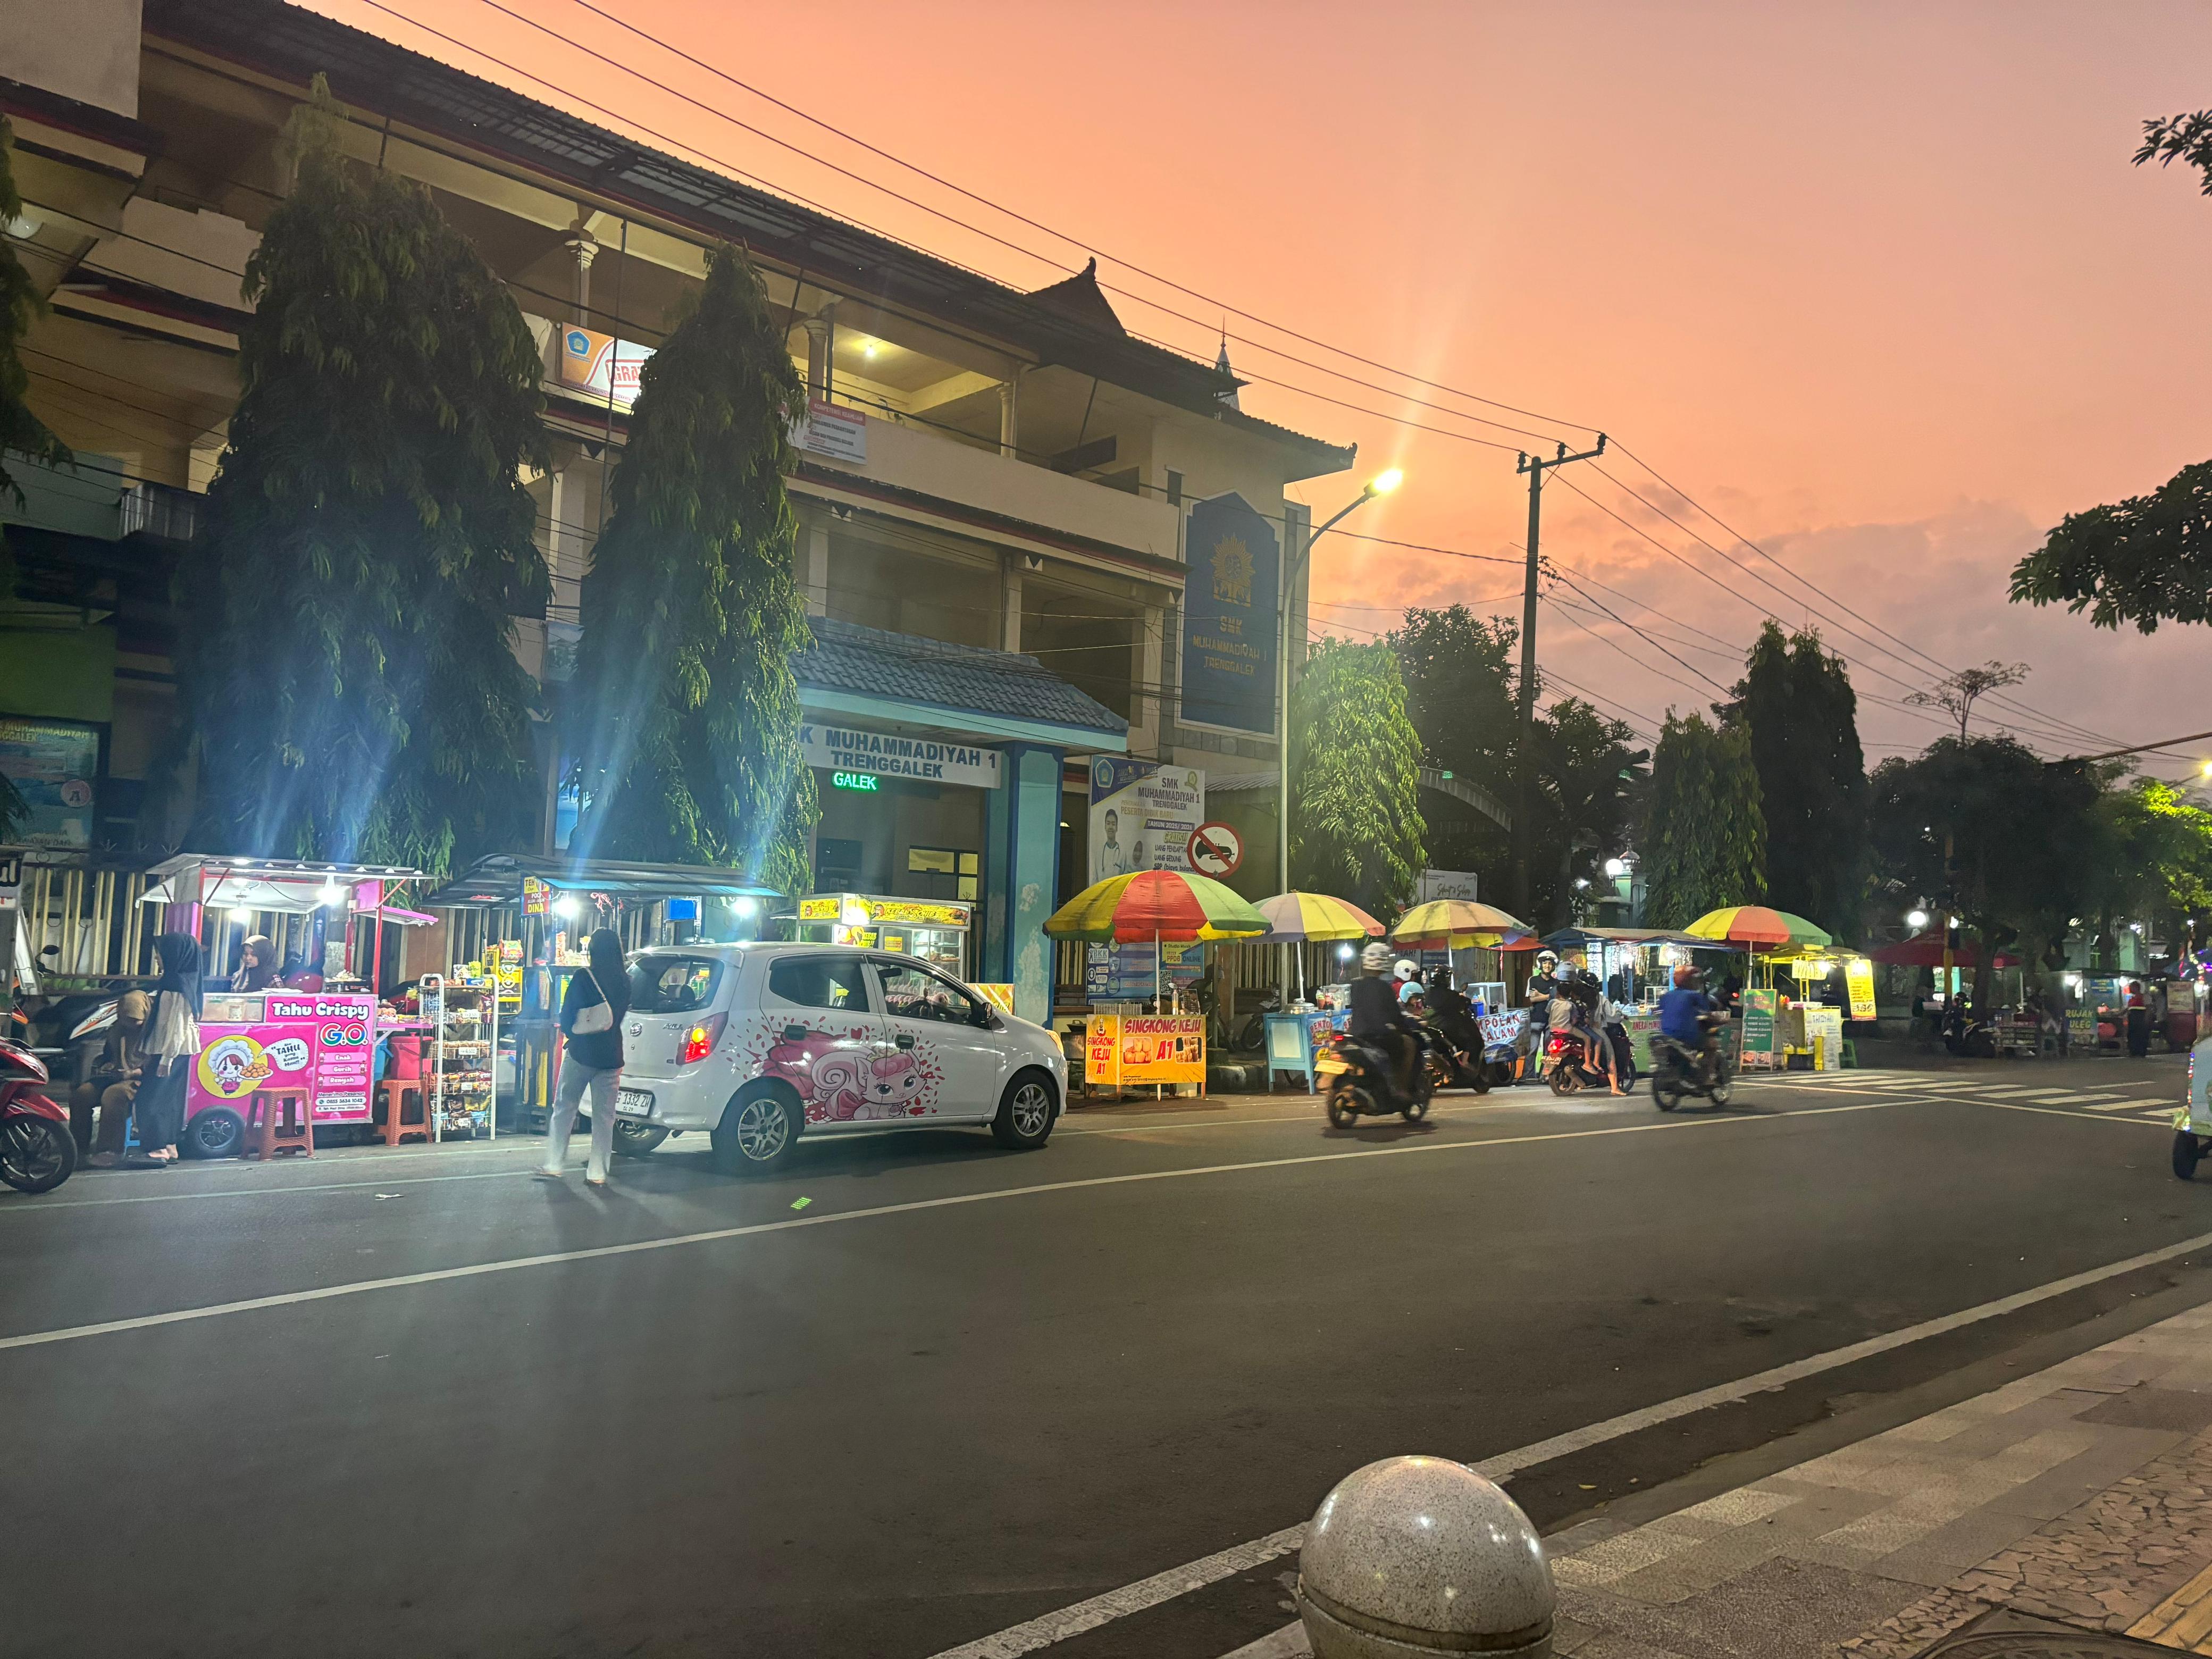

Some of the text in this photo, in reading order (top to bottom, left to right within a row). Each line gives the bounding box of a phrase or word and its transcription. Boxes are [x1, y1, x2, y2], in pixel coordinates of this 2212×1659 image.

[1220, 616, 1243, 635] SMK
[1204, 656, 1255, 676] TRENGGALEK
[825, 729, 981, 767] MUHAMMADIYAH
[988, 753, 996, 769] 1
[831, 750, 943, 779] TRENGGALEK
[833, 772, 877, 791] GALEK
[1162, 777, 1178, 790] SMK
[1138, 787, 1200, 803] MUHAMMADIYAH 1
[1152, 799, 1187, 810] TRENGGALEK
[1120, 807, 1143, 817] PESERTA
[1160, 811, 1174, 819] BARU
[527, 903, 544, 914] DINA
[272, 1002, 369, 1020] Tahu Crispy
[2065, 1009, 2093, 1018] RUJAK
[1124, 1018, 1202, 1034] SINGKONG KEJU
[1087, 1036, 1115, 1046] SINGKONG
[1482, 1027, 1516, 1041] ALAM
[1092, 1048, 1111, 1061] KEJU
[1155, 1039, 1175, 1061] A1
[1096, 1063, 1106, 1075] A1
[623, 1093, 640, 1106] 1332
